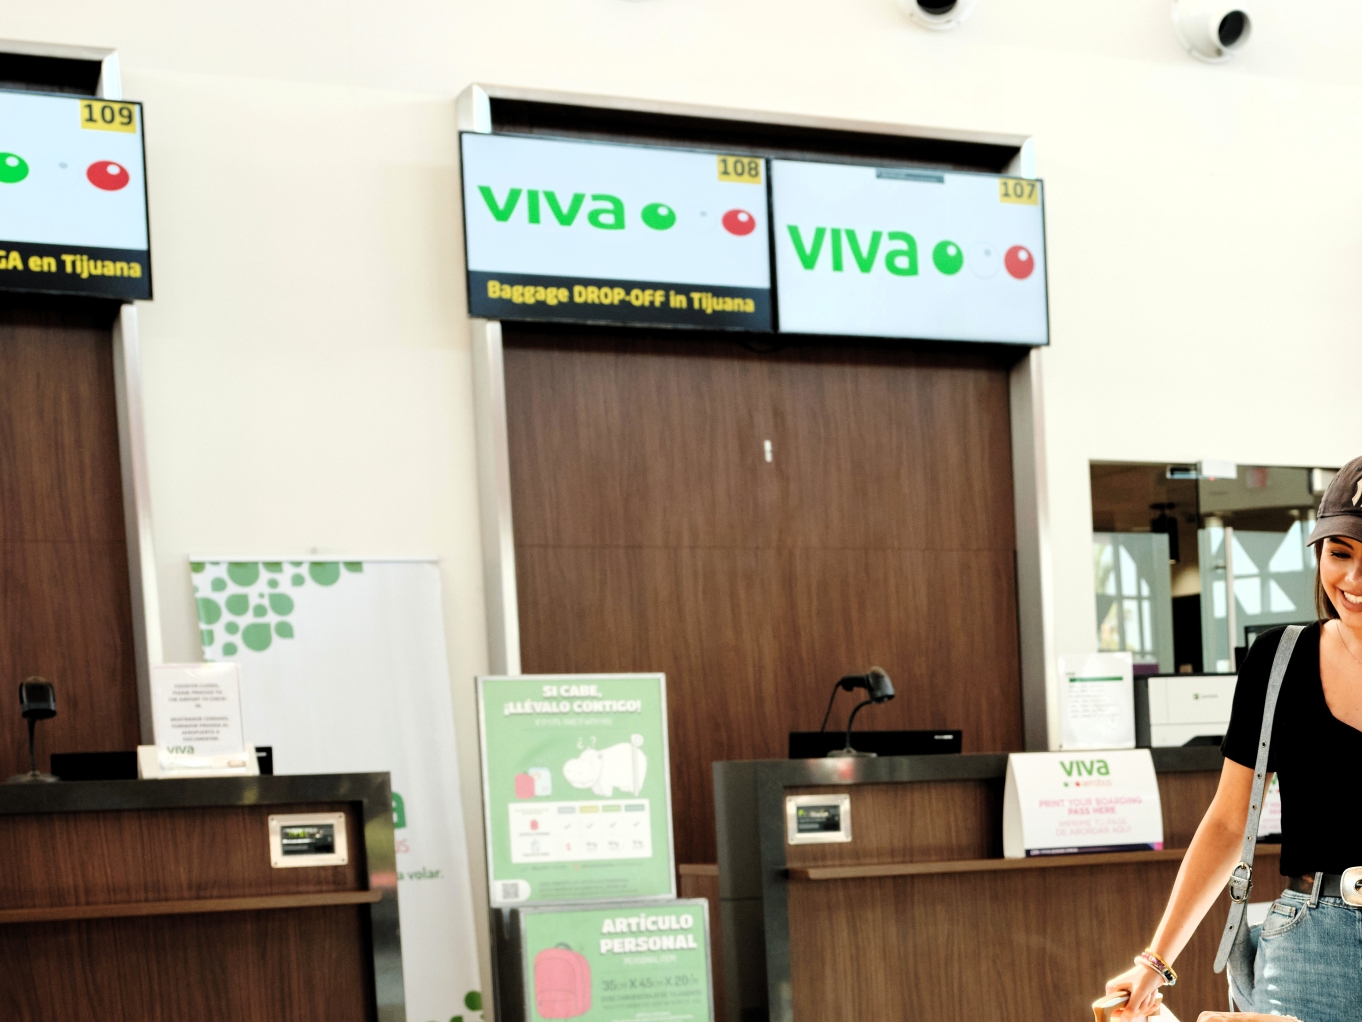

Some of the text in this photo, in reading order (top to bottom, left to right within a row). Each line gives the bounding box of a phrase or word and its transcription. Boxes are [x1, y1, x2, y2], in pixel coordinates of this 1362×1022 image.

[84, 103, 134, 127] 109
[720, 158, 760, 178] 108
[1001, 181, 1036, 200] 107
[478, 185, 626, 230] viva
[786, 224, 919, 277] viva
[28, 255, 57, 272] en
[61, 253, 142, 279] Tijuana
[487, 280, 755, 314] Baggage DROP-OFF in Tijuana
[543, 684, 602, 698] SI CABE,
[573, 699, 641, 713] CONTIGO!
[166, 745, 195, 754] viva
[1059, 759, 1110, 777] viva
[601, 912, 694, 934] ARTÍCULO
[599, 933, 698, 954] PERSONAL
